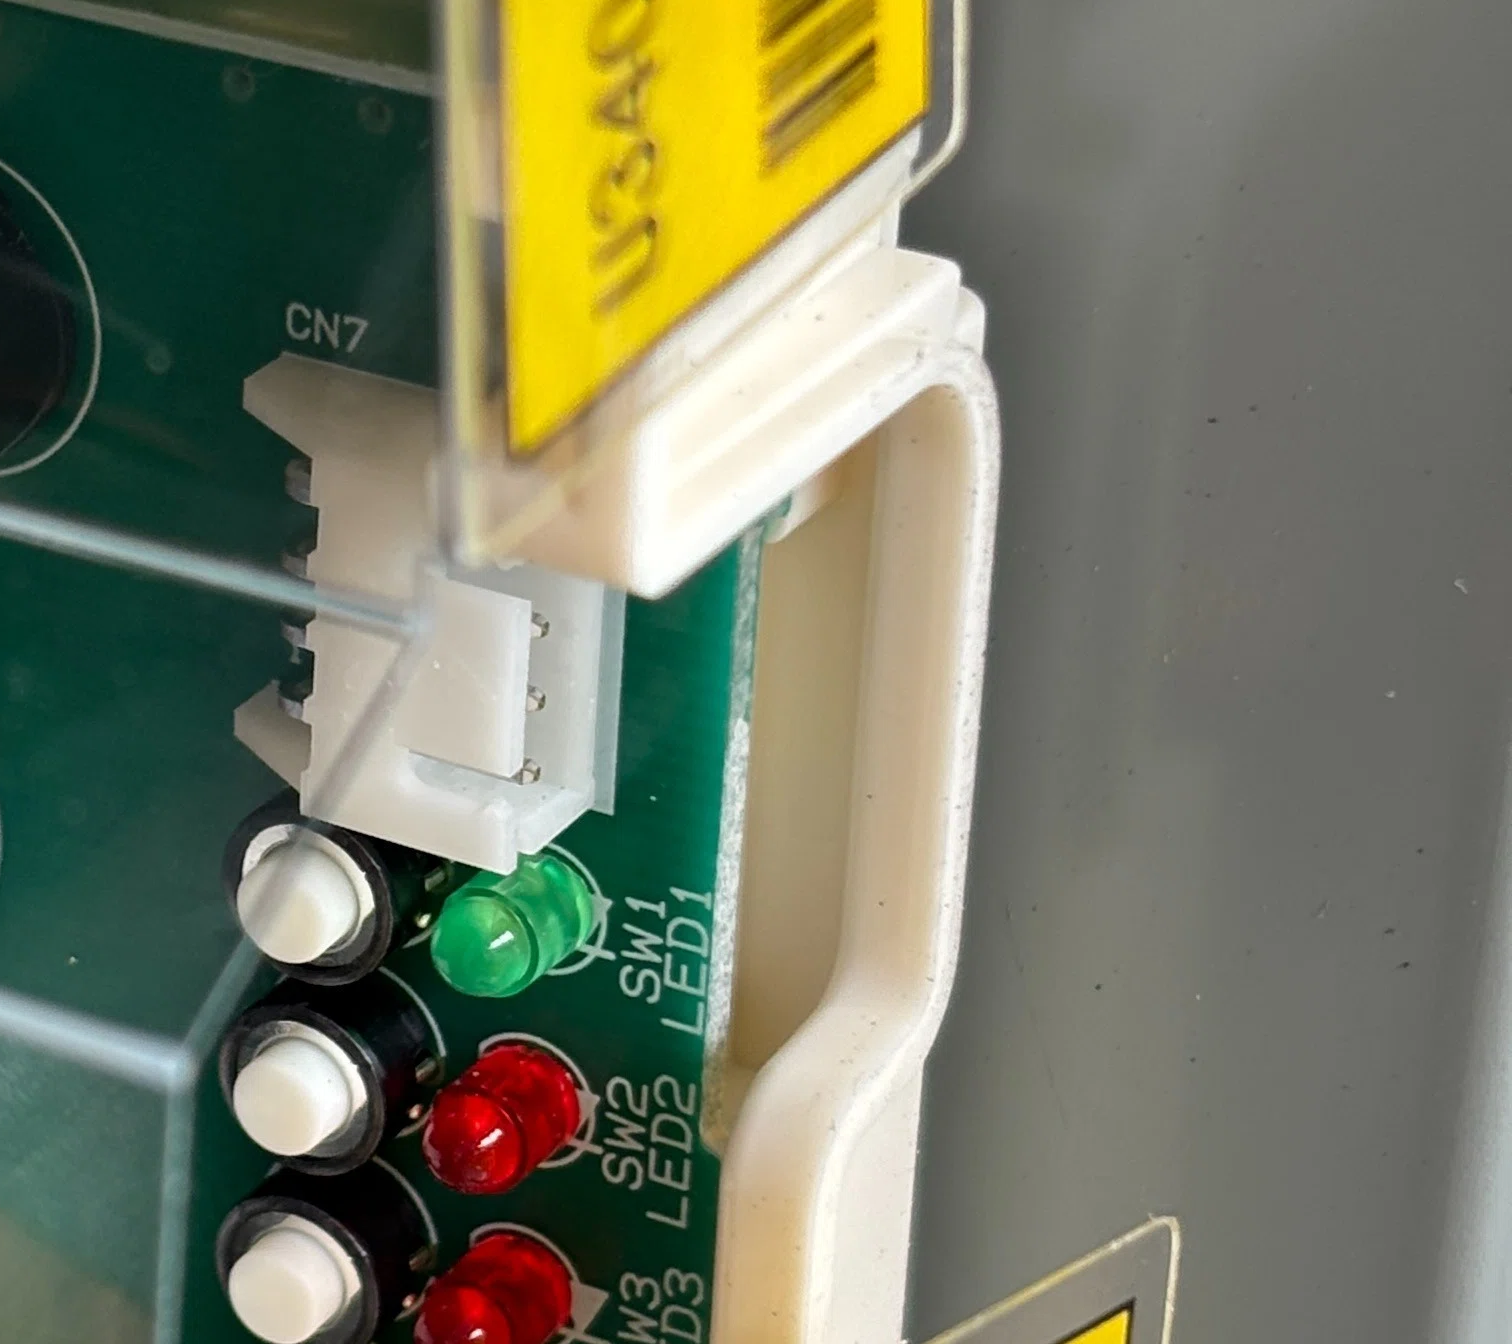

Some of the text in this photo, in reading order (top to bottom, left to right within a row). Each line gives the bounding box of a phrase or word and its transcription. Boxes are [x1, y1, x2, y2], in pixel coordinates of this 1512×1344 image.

[285, 301, 368, 353] CN7
[619, 896, 666, 1003] SW1
[661, 884, 714, 1034] LED1
[601, 1076, 648, 1190] SW2
[647, 1074, 696, 1227] LED2
